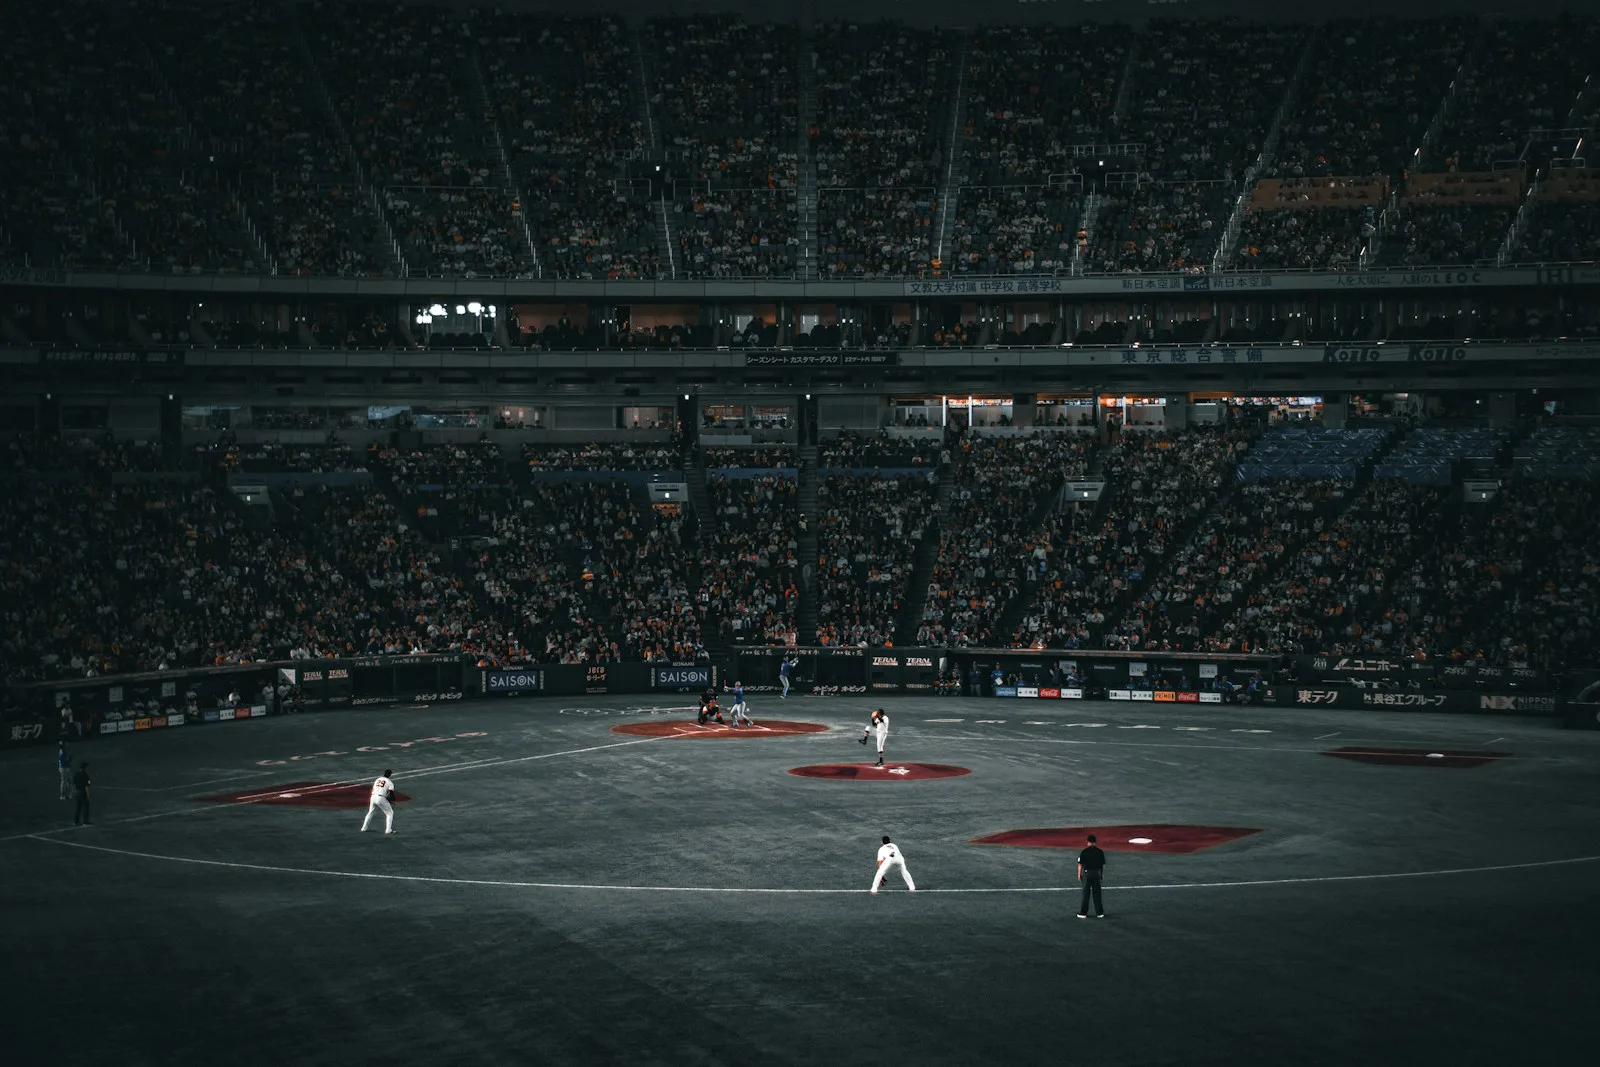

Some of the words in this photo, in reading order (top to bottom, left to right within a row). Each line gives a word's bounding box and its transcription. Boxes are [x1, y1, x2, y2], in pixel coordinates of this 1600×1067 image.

[1213, 276, 1272, 288] 新日本空調
[1433, 273, 1482, 284] LEOC
[1535, 269, 1574, 284] IHI
[911, 281, 976, 294] 文教大学付属
[981, 280, 1014, 292] 中学校
[1017, 280, 1062, 292] 高等学校
[1122, 279, 1181, 290] 新日本空調
[747, 356, 789, 364] シーズンシート
[790, 355, 838, 364] カスタマーデスク
[1121, 348, 1263, 363] 東京総合警備
[1353, 659, 1400, 671] ユニホー
[490, 675, 536, 687] SAISON
[660, 671, 707, 683] SAISON
[1297, 690, 1338, 704] 東テク
[1373, 693, 1447, 706] 長谷工グループ
[1518, 696, 1555, 704] NIPPON
[9, 724, 43, 741] 東テク
